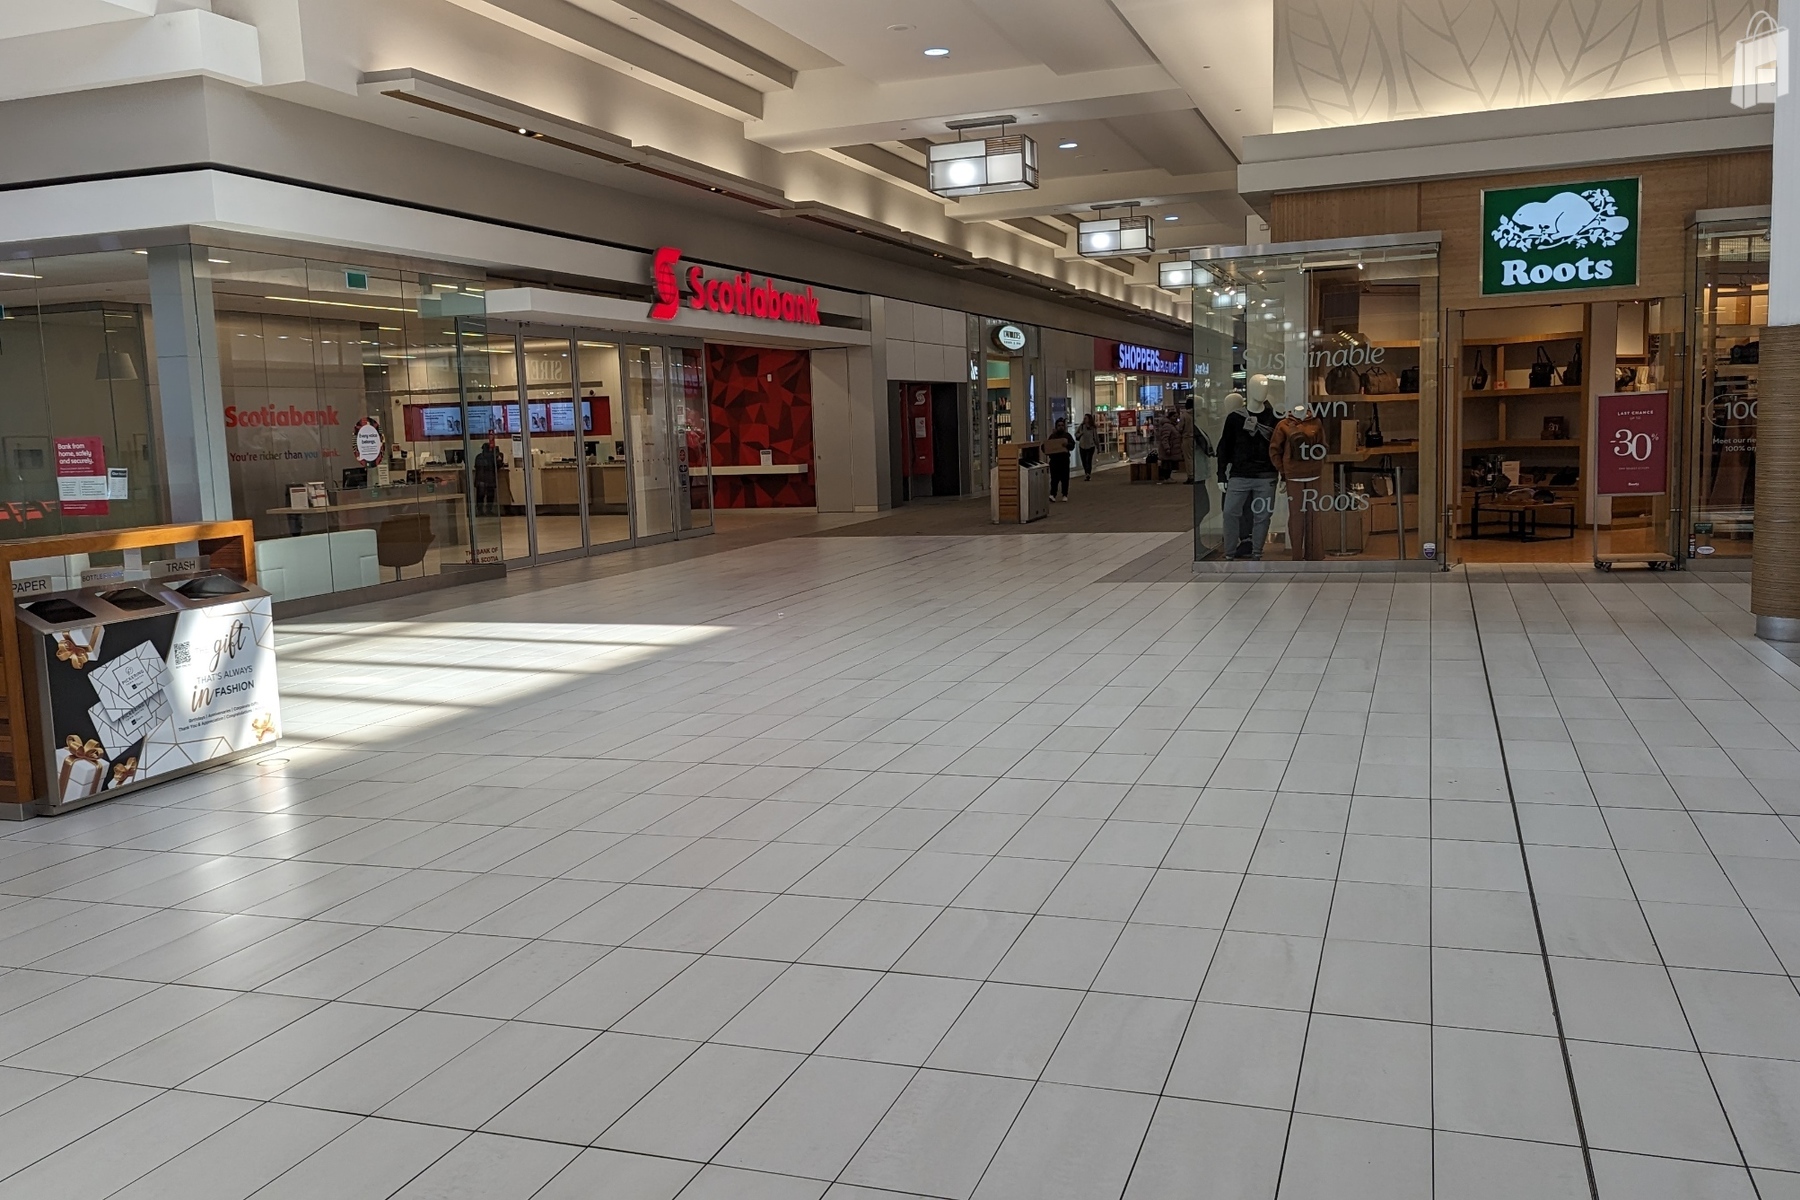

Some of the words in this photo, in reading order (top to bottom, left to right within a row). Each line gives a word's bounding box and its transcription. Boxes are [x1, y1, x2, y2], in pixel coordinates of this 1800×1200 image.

[1501, 257, 1613, 286] Roots
[687, 266, 821, 325] Scotiabank
[1119, 343, 1160, 372] SHOPPERS
[224, 404, 340, 428] Scotiabank
[229, 452, 258, 462] You're
[259, 451, 283, 461] richer
[284, 451, 303, 460] than
[303, 451, 319, 460] you
[1299, 441, 1326, 460] to
[1301, 488, 1370, 513] Roots
[166, 560, 196, 573] TRASH
[12, 579, 47, 594] PAPER
[209, 619, 250, 673] gift
[197, 672, 222, 684] THAT'S
[224, 665, 253, 679] ALWAYS
[191, 685, 214, 712] in
[215, 680, 255, 698] FASHION
[188, 715, 206, 723] Birthdays
